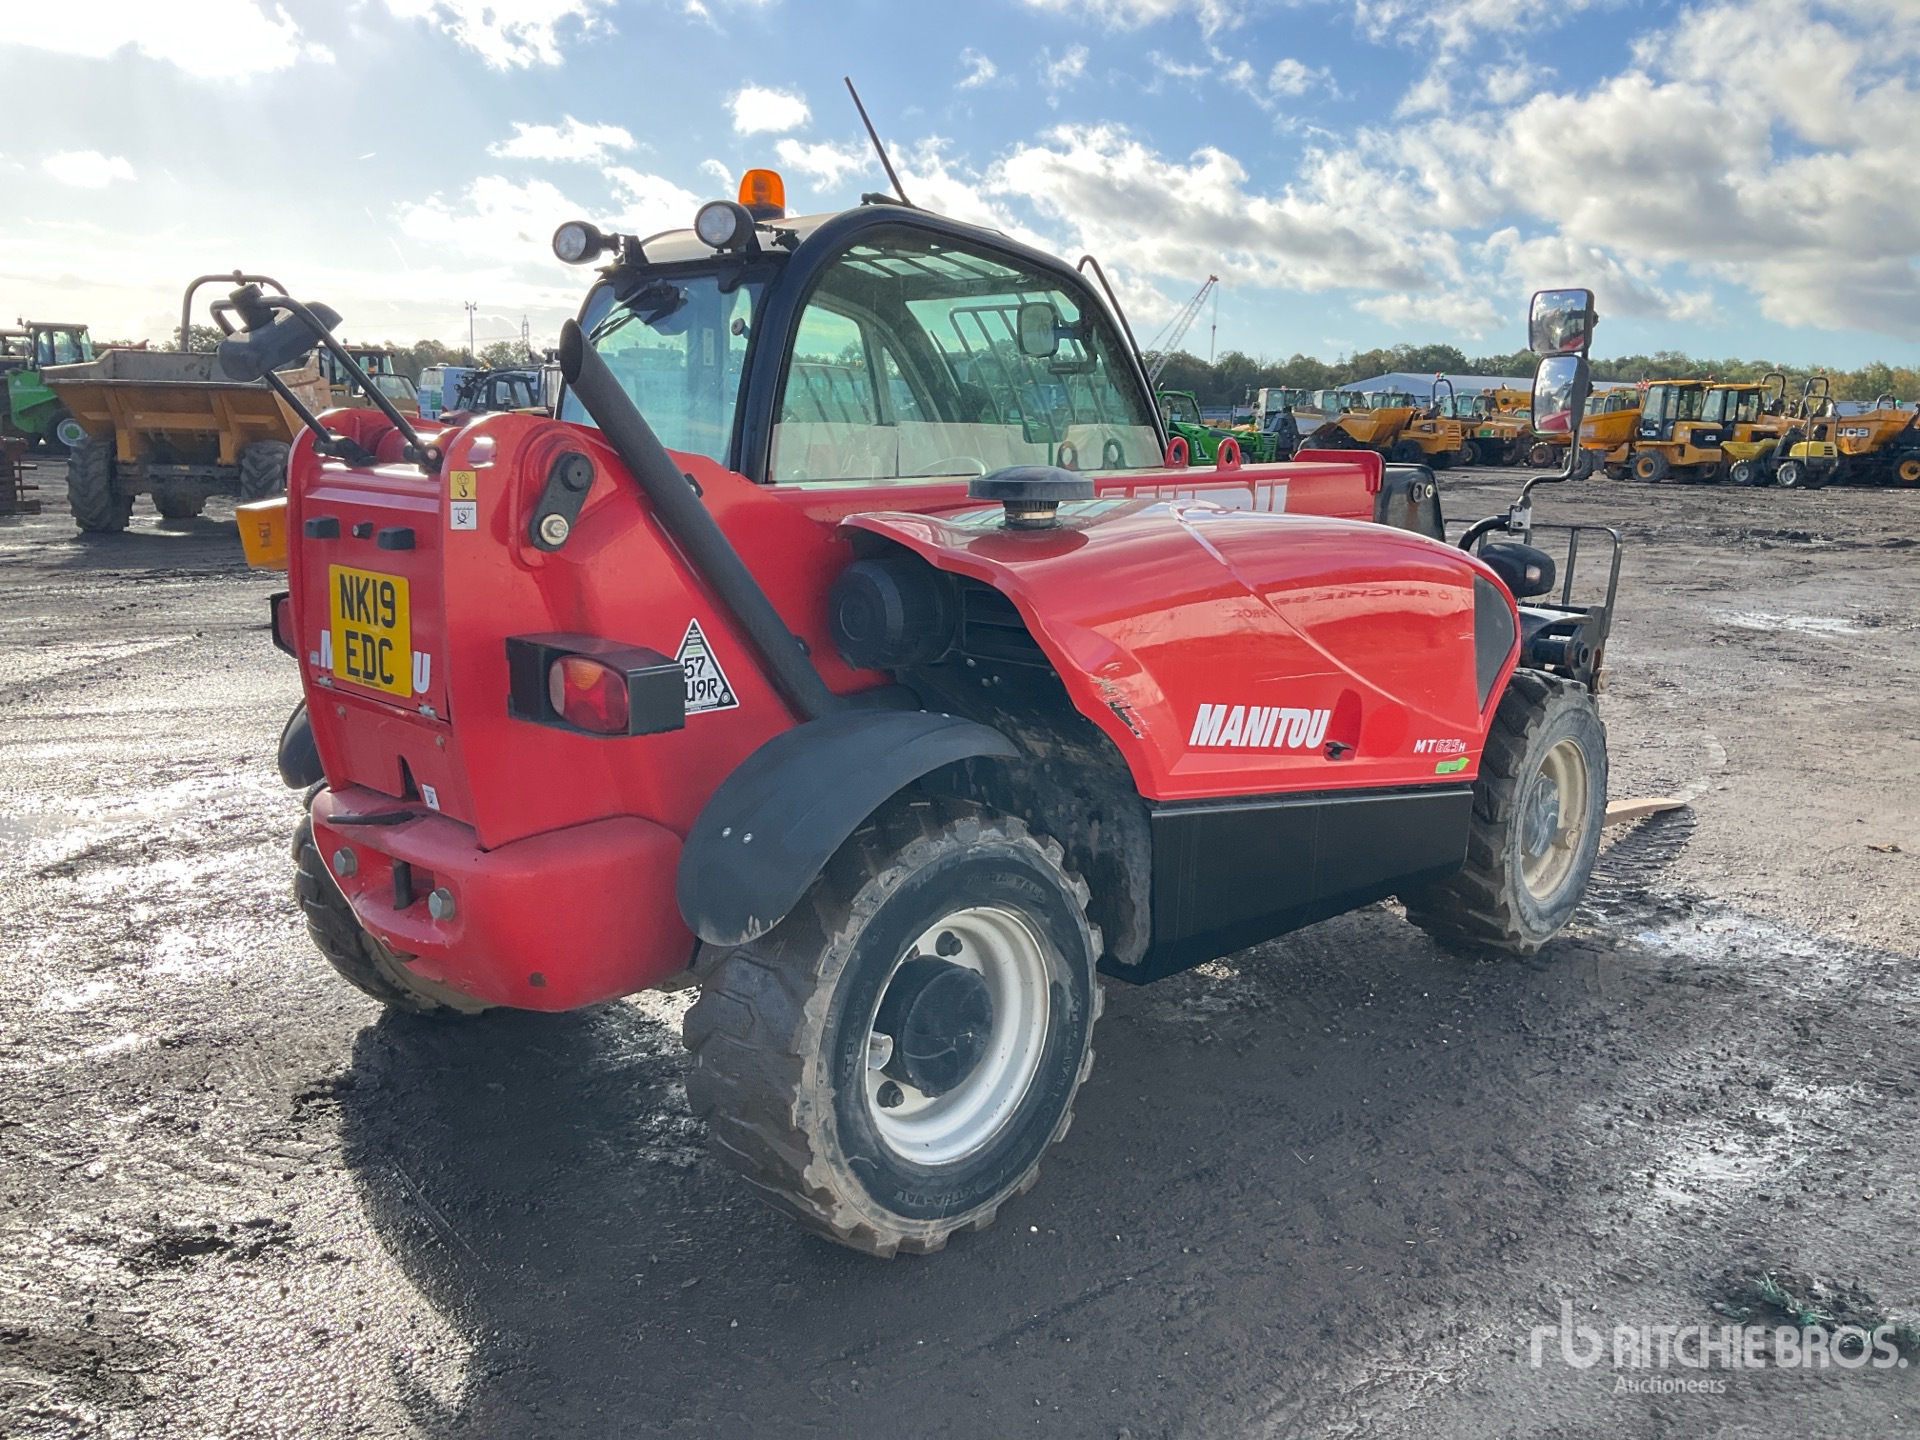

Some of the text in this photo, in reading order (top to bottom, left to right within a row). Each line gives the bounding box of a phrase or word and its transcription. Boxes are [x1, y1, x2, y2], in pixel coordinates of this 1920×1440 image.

[1835, 428, 1868, 437] JCB
[339, 573, 396, 629] NK19
[345, 629, 394, 685] EDC
[684, 656, 705, 679] 57
[1188, 703, 1331, 749] MANITOU
